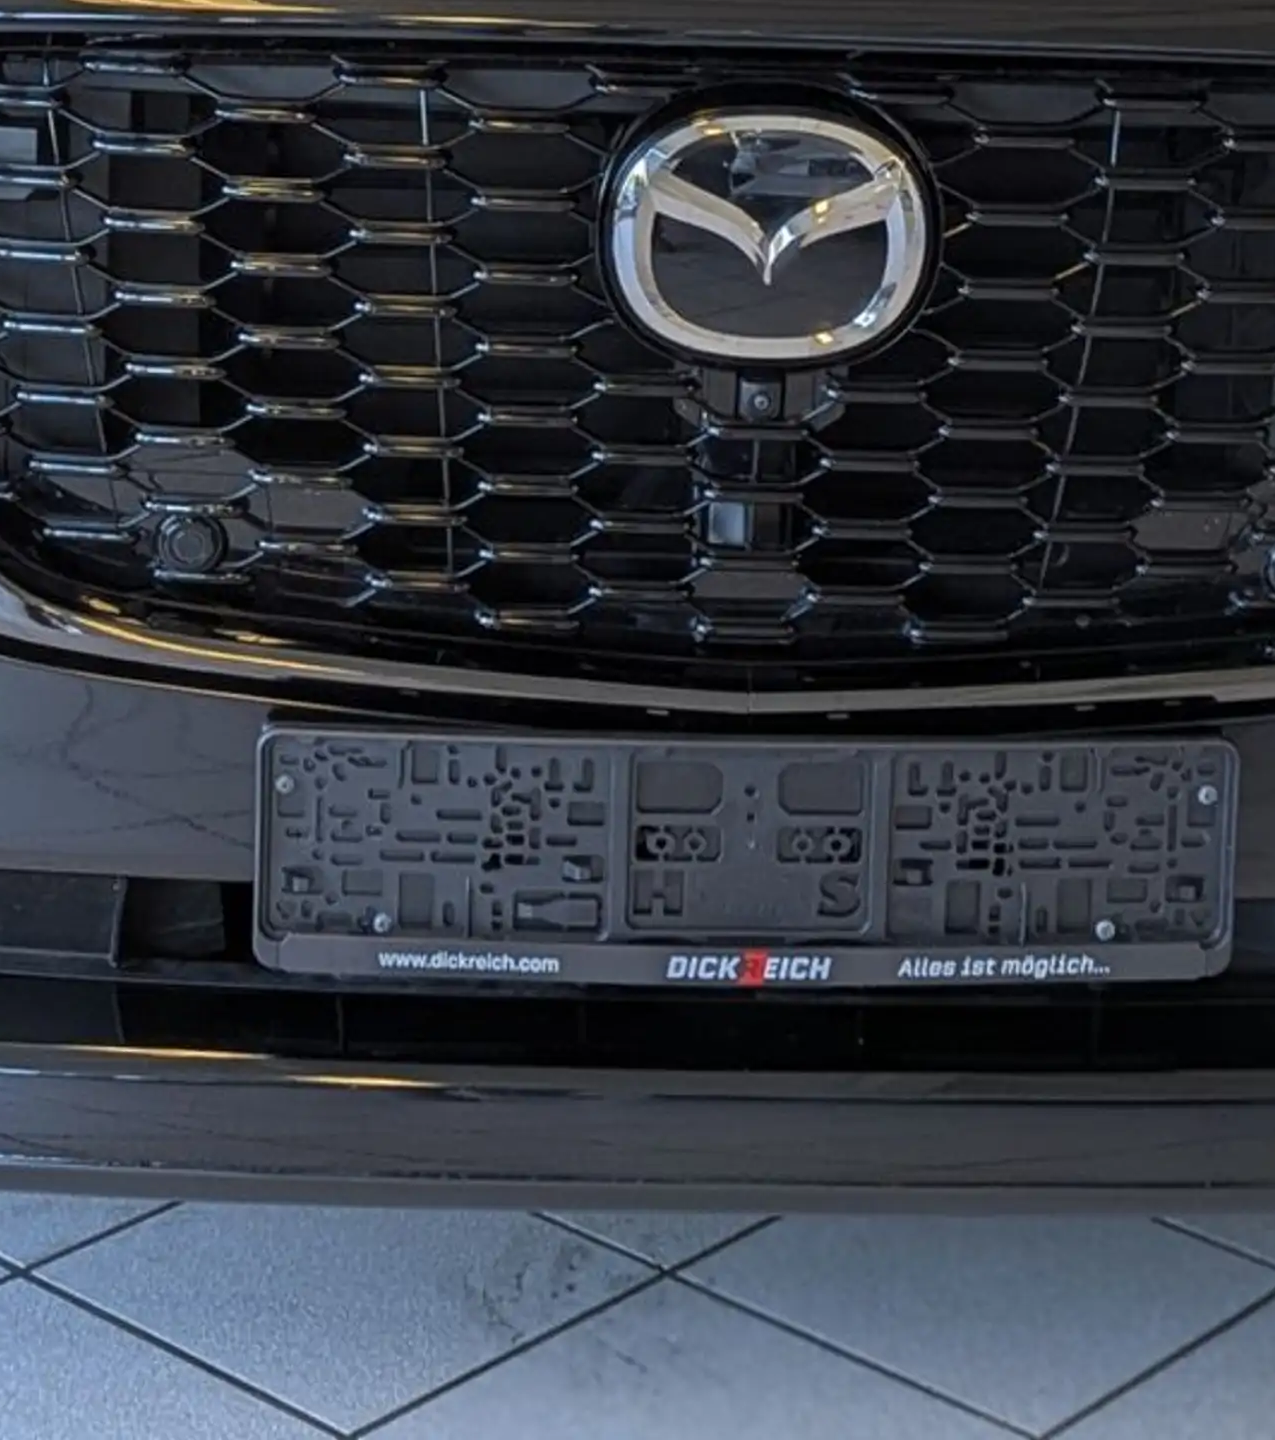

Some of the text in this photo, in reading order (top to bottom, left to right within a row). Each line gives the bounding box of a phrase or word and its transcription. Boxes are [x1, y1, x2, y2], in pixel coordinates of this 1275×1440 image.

[379, 950, 560, 973] www.dickreich.com
[897, 955, 957, 978] Alles
[960, 954, 996, 977] ist
